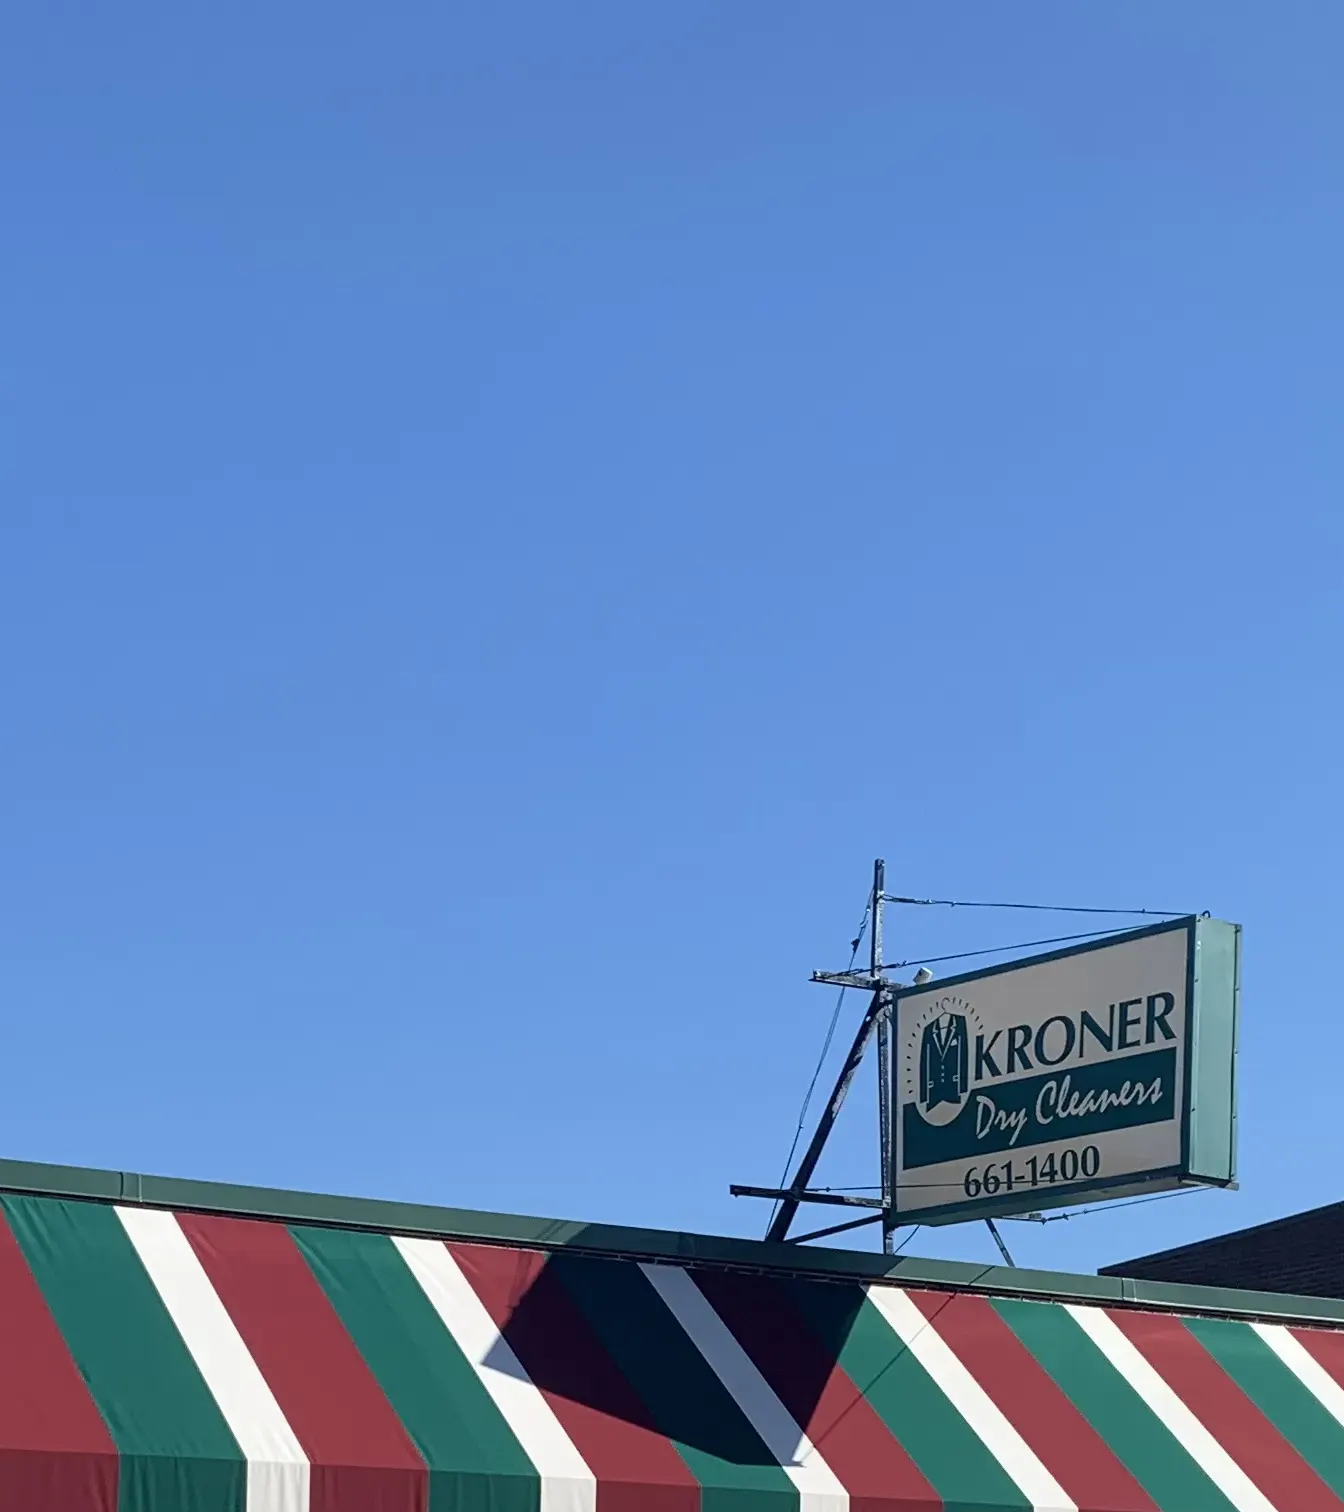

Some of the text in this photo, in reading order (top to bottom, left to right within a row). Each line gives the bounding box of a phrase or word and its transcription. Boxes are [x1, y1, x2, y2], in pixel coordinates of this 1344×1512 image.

[974, 991, 1178, 1081] KRONER
[975, 1074, 1164, 1146] Dry Cleaners
[963, 1145, 1101, 1198] 661-1400
